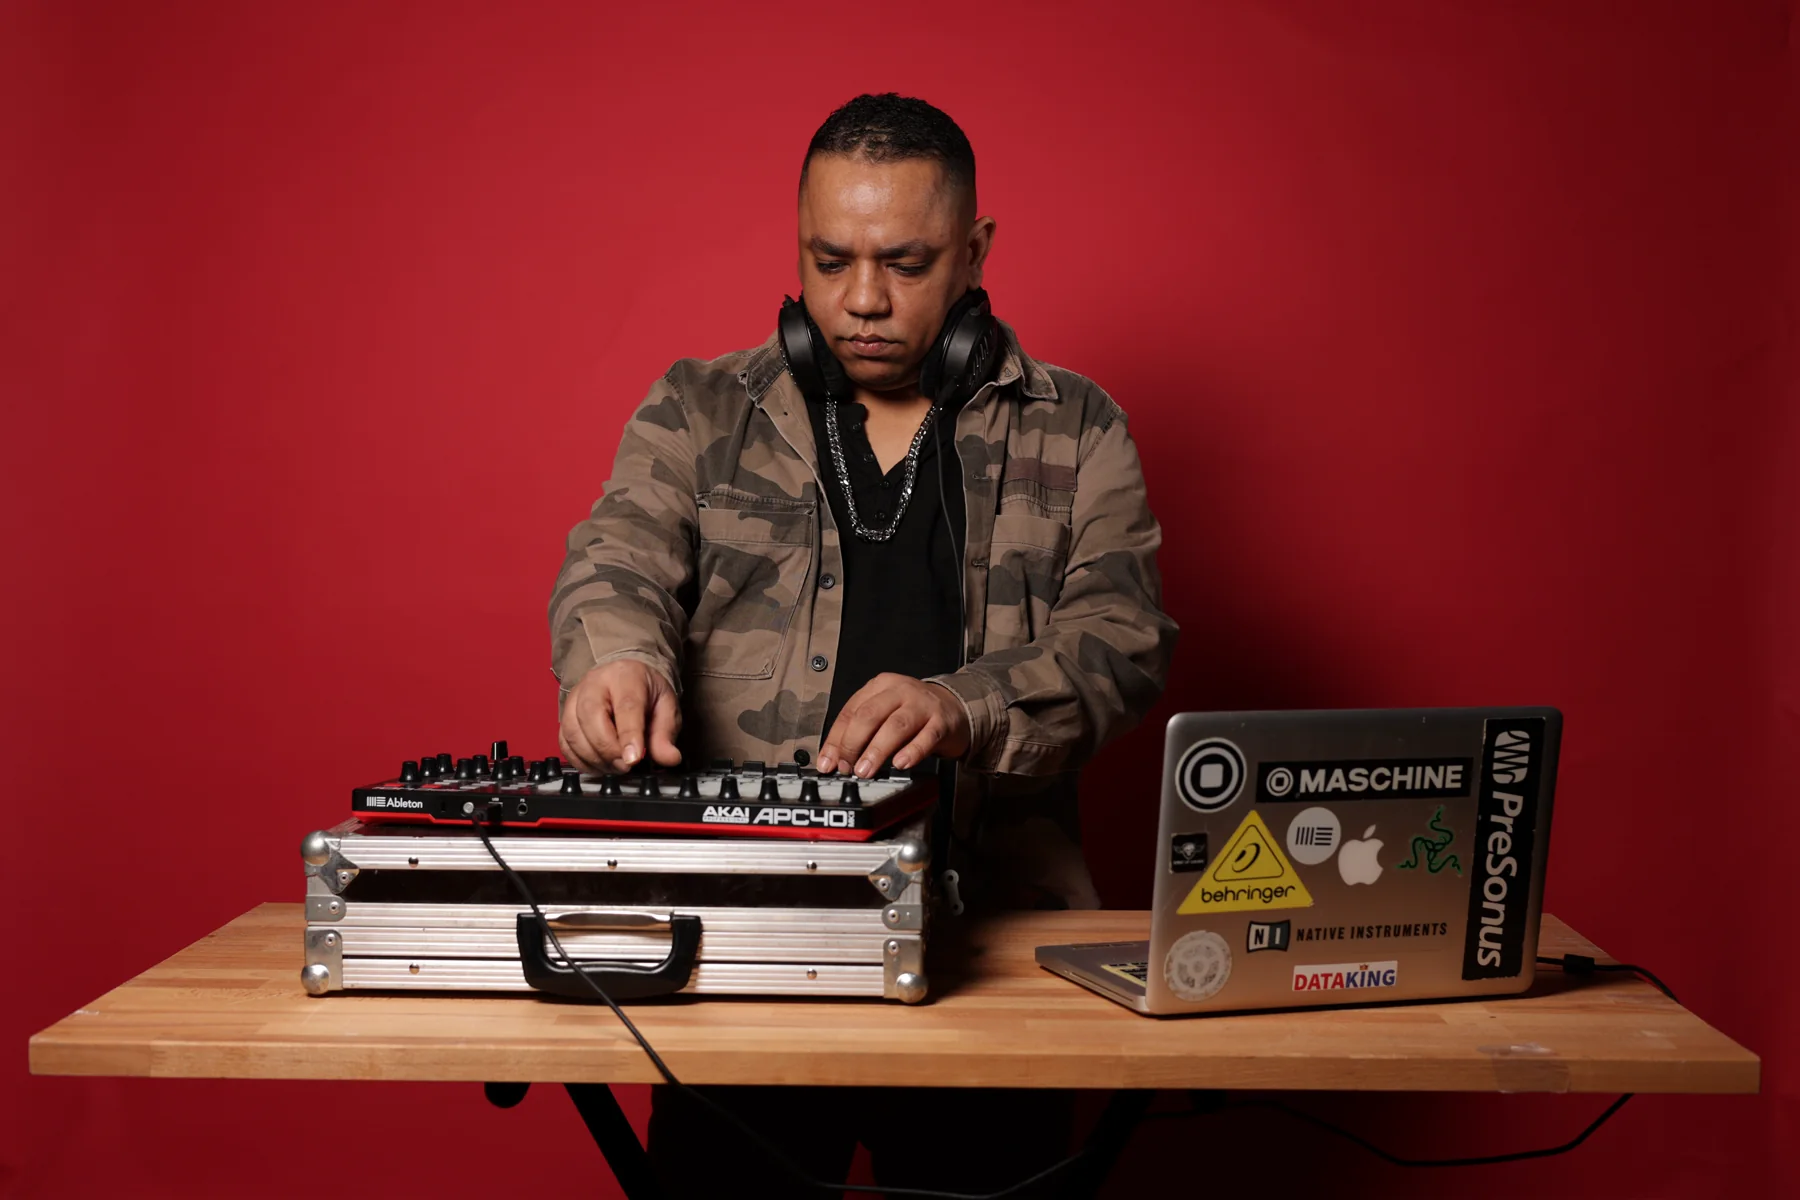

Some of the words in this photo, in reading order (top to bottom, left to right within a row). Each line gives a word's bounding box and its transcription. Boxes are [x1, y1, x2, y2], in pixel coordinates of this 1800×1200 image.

[1299, 765, 1464, 794] MASCHINE
[386, 798, 423, 809] Ableton
[703, 806, 750, 818] AKAI
[752, 808, 847, 828] APC40
[1476, 791, 1525, 968] PreSonus
[1201, 885, 1296, 904] behringer
[1296, 927, 1345, 942] NATIVE
[1350, 922, 1448, 940] INSTRUMENTS
[1294, 969, 1396, 991] DATAKING
